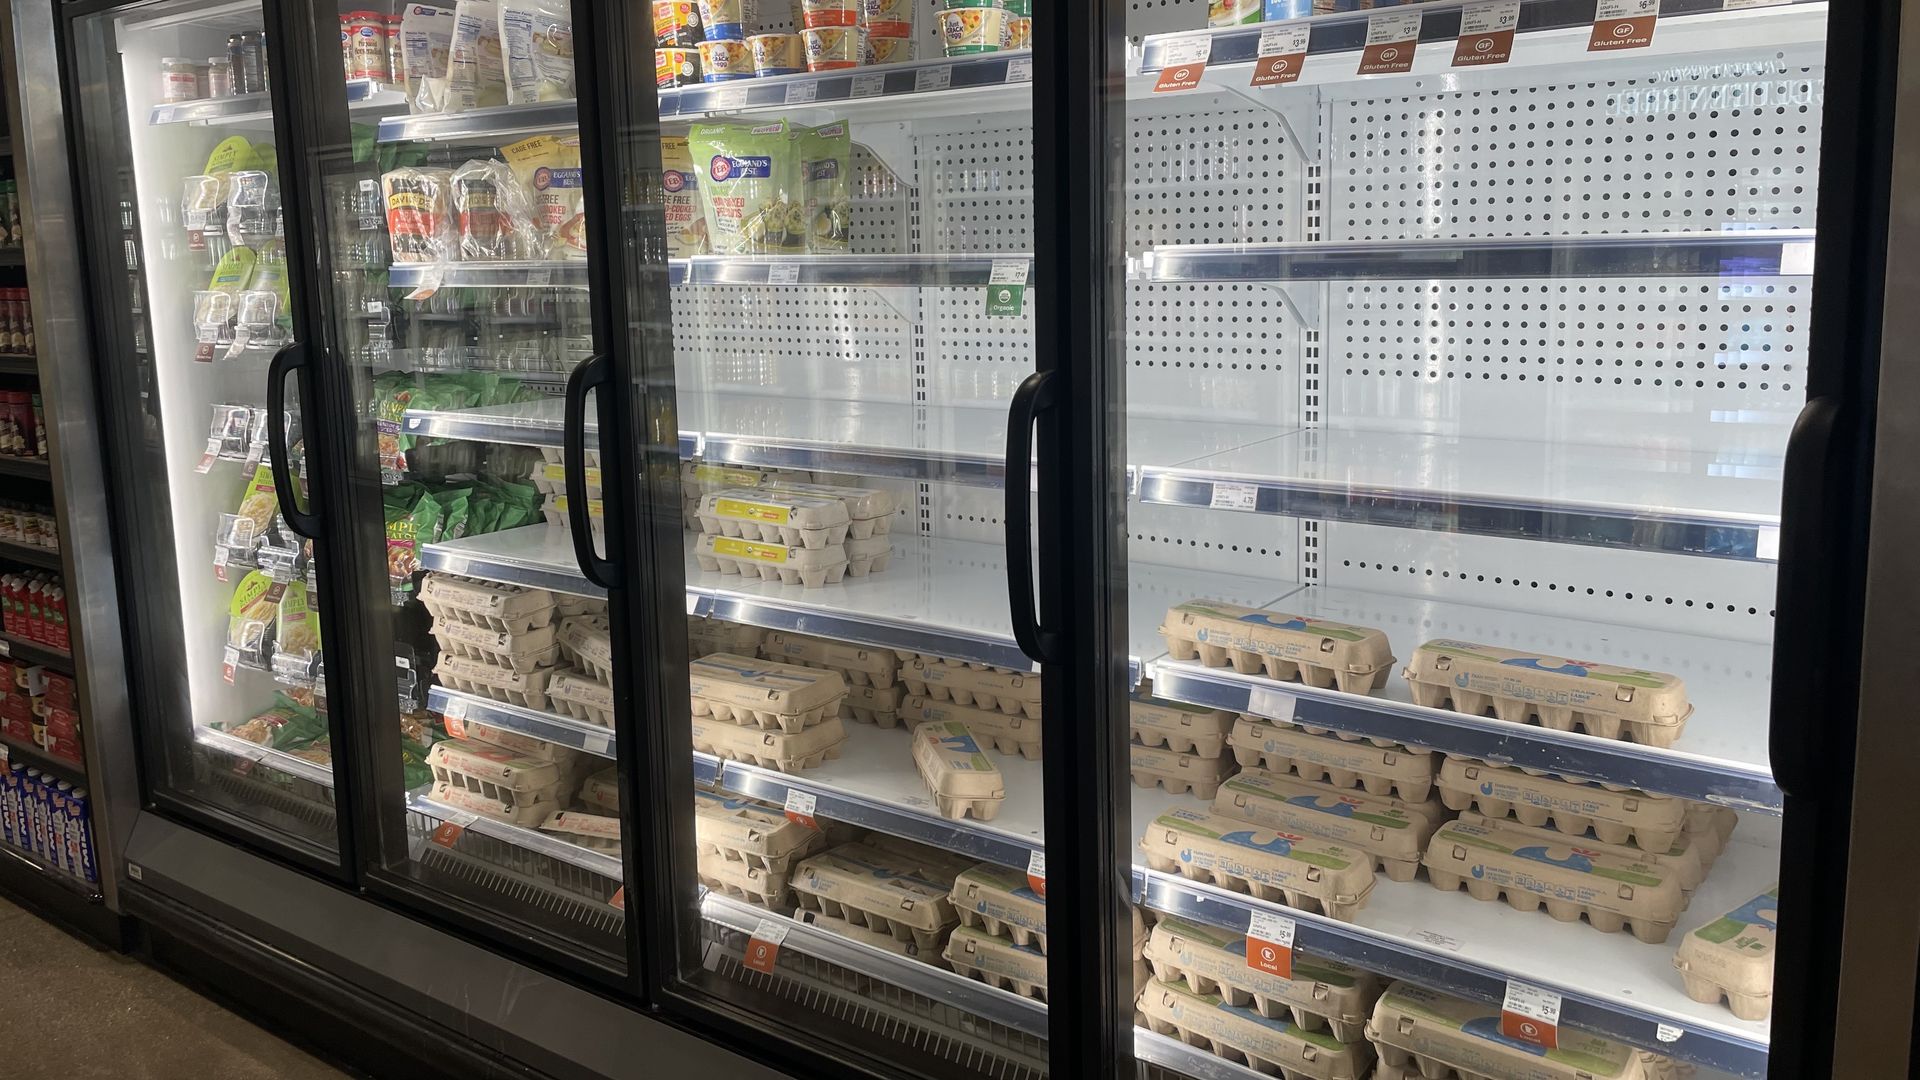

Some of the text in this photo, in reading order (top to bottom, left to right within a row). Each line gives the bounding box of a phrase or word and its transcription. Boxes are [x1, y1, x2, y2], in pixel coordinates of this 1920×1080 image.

[512, 139, 543, 154] CAGE FREE
[673, 196, 691, 204] FREE
[665, 204, 696, 212] D-COOKED
[674, 213, 692, 221] EGGS
[1260, 961, 1278, 970] Local
